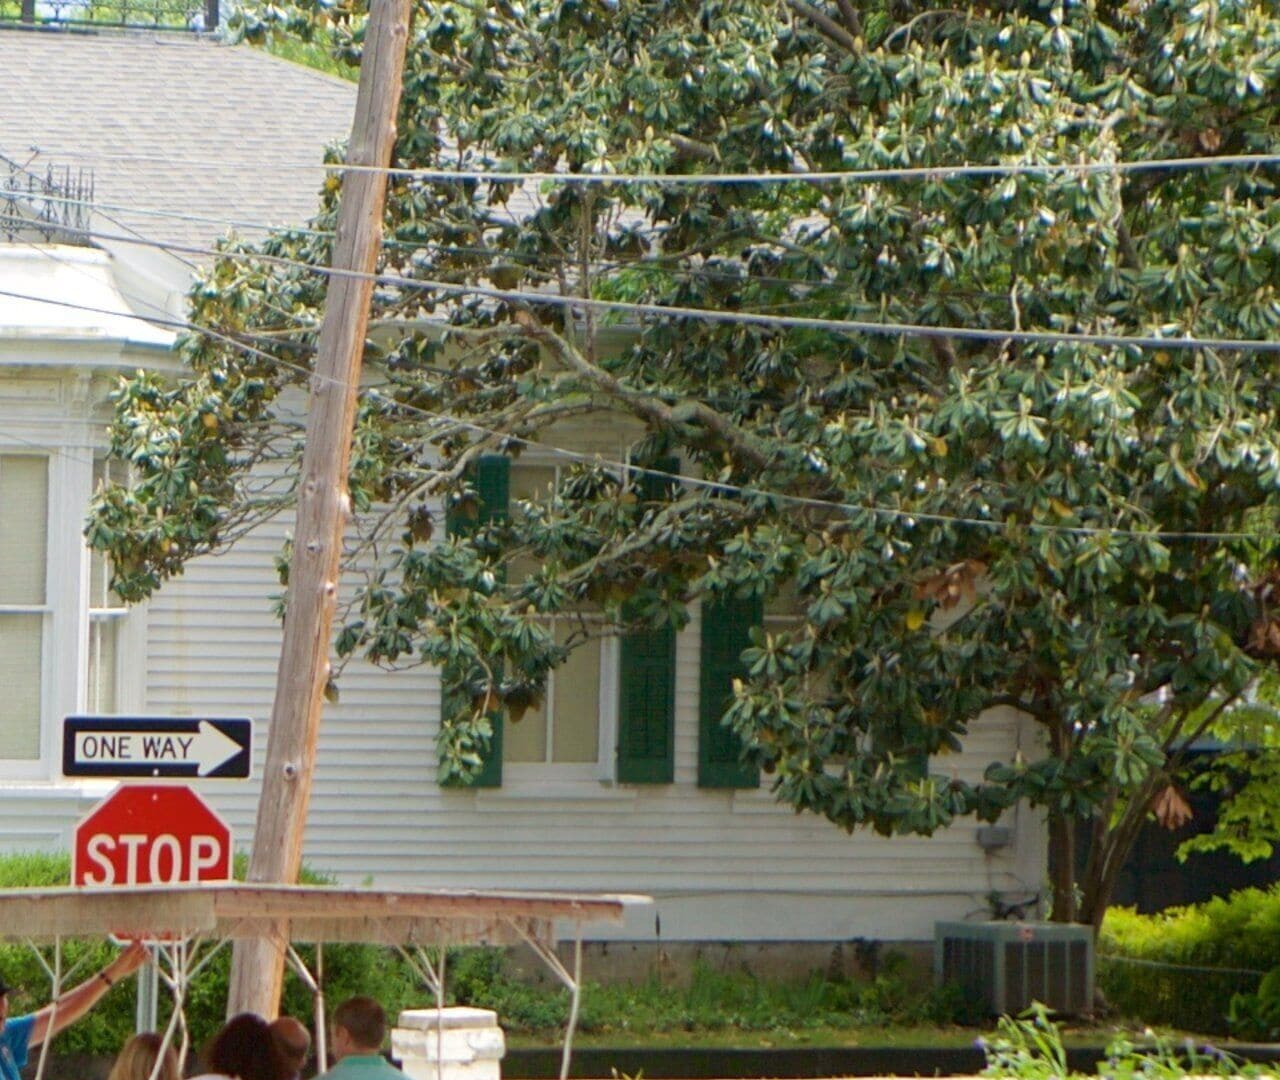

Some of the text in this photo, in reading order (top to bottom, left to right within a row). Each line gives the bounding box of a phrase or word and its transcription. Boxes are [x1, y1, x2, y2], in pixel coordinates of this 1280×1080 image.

[82, 736, 193, 759] ONE WAY
[83, 833, 221, 887] STOP
